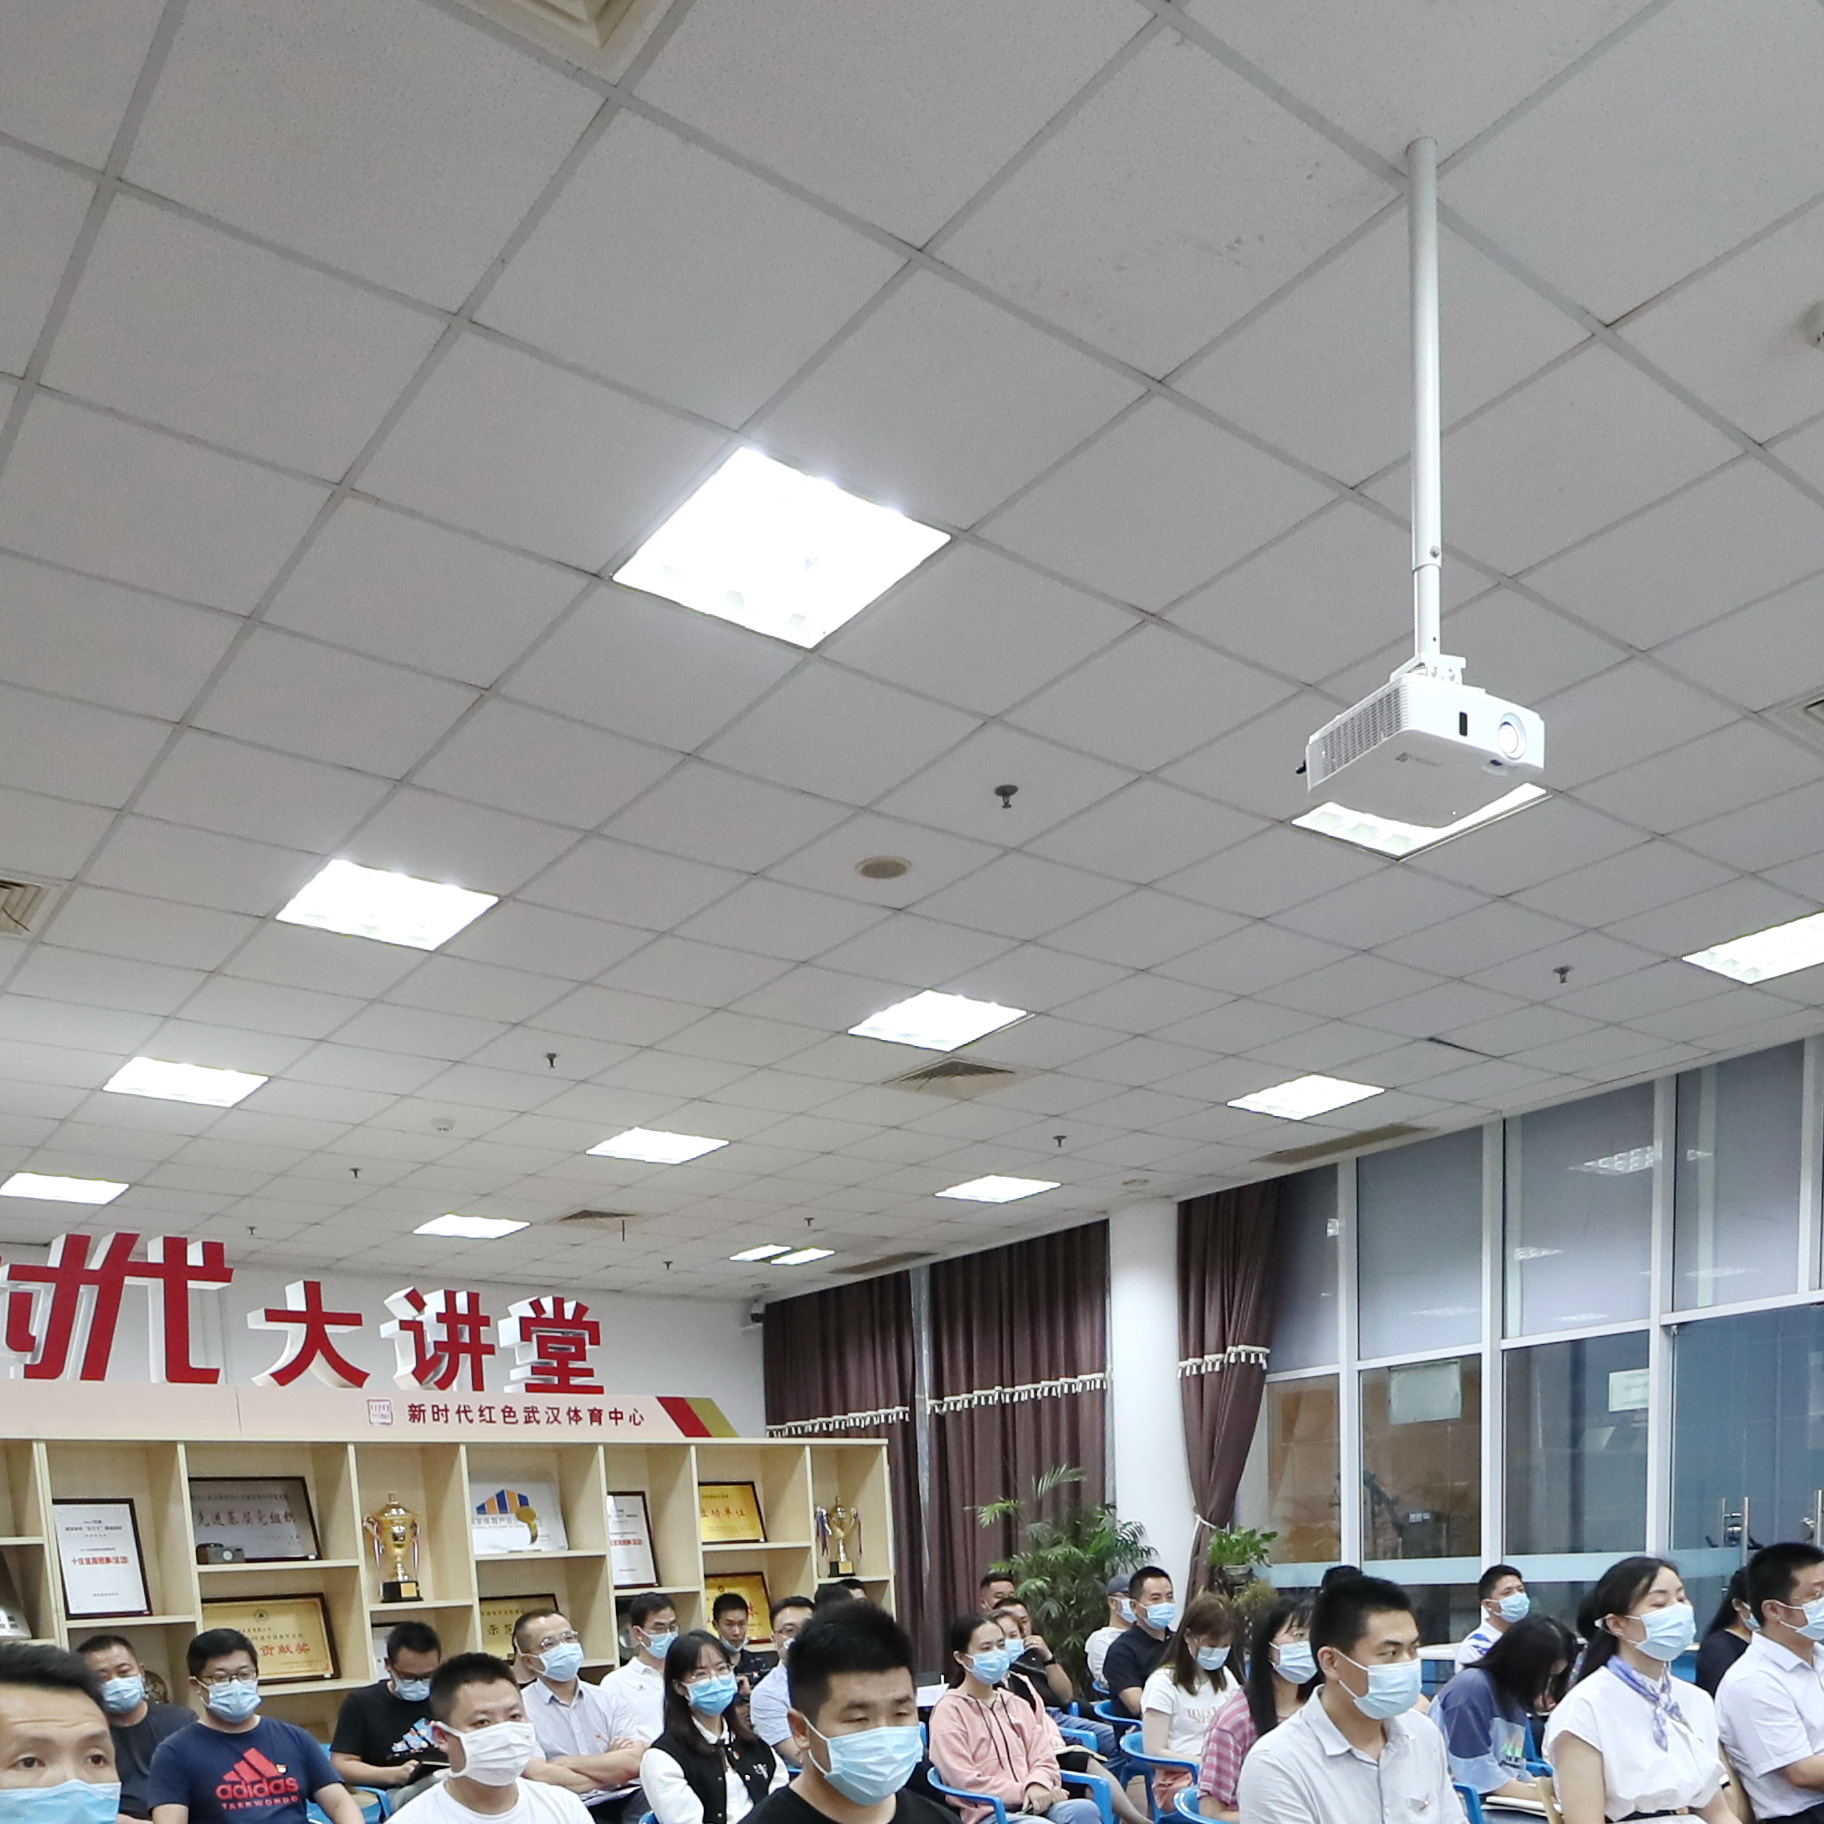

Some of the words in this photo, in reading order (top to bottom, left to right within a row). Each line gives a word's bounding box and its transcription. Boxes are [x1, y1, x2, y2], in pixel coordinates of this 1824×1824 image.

[263, 1280, 604, 1395] 大讲堂
[407, 1403, 645, 1426] 新时代红色武汉体育中心
[216, 1777, 299, 1799] adidas
[221, 1795, 299, 1810] TAEKWONDO
